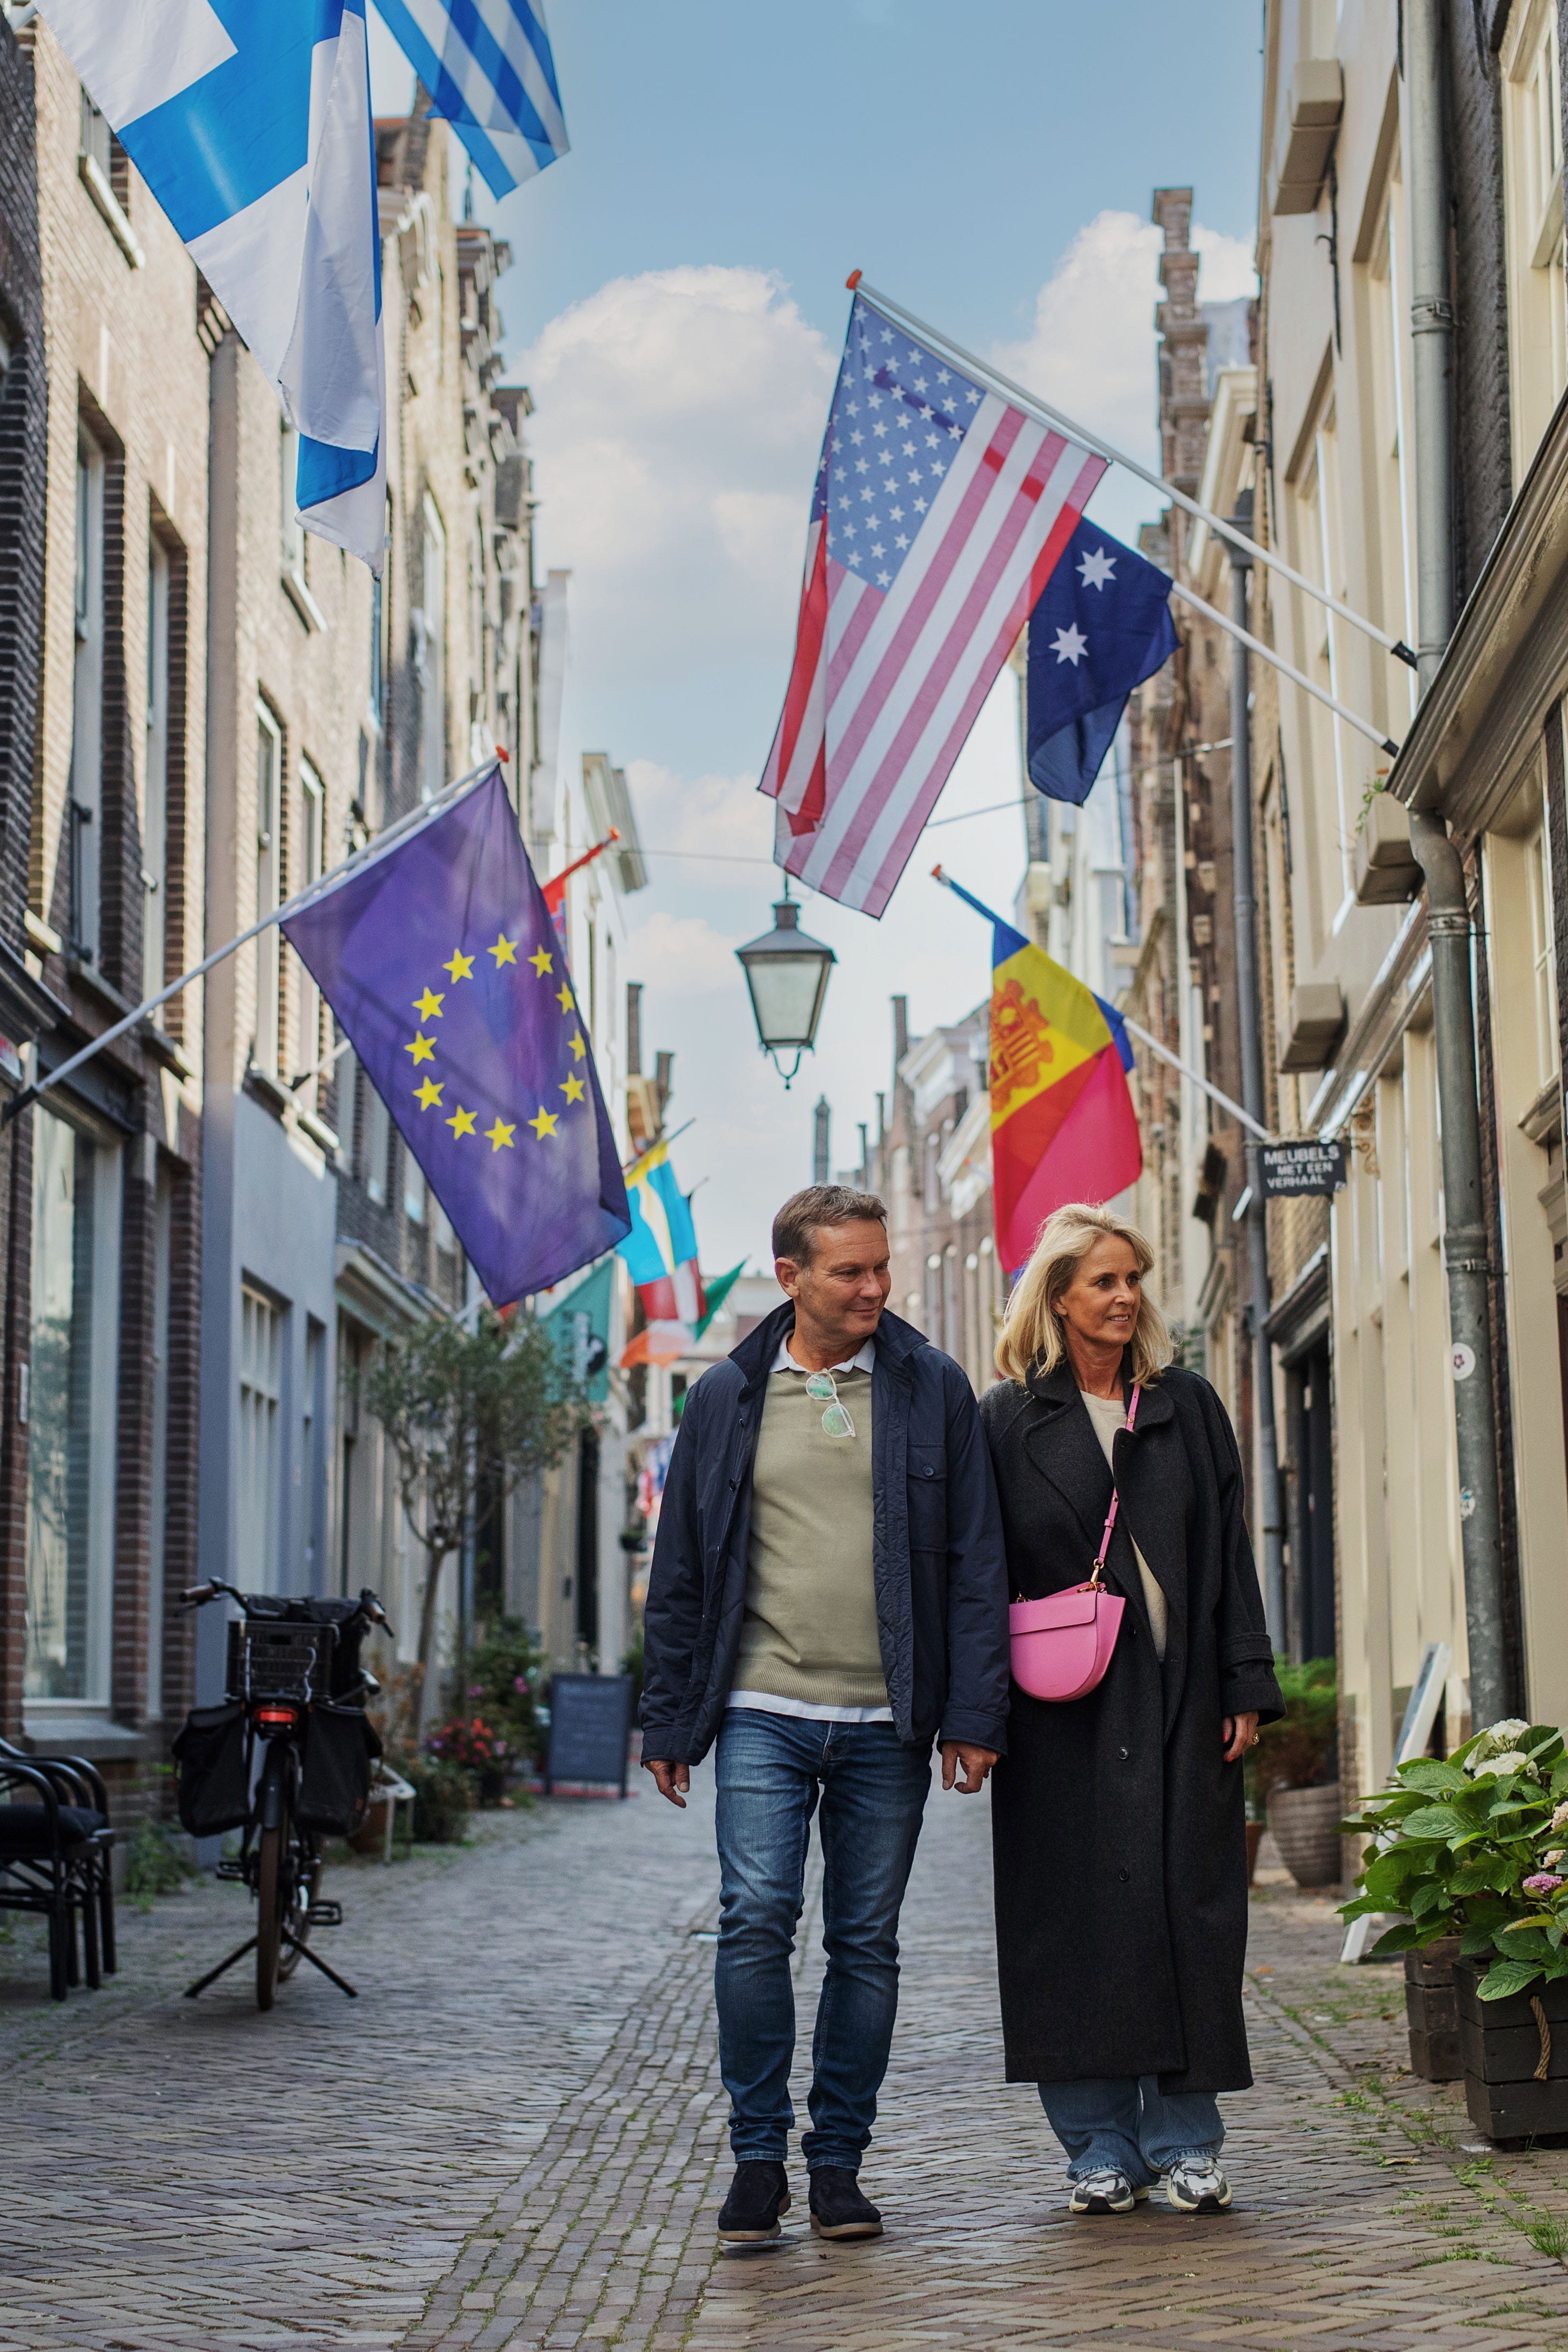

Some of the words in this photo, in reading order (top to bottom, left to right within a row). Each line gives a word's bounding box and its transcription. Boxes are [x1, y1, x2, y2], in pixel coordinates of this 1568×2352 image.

[1264, 1145, 1339, 1166] MEUBELS
[1277, 1164, 1302, 1175] MET
[1307, 1162, 1333, 1174] EEN
